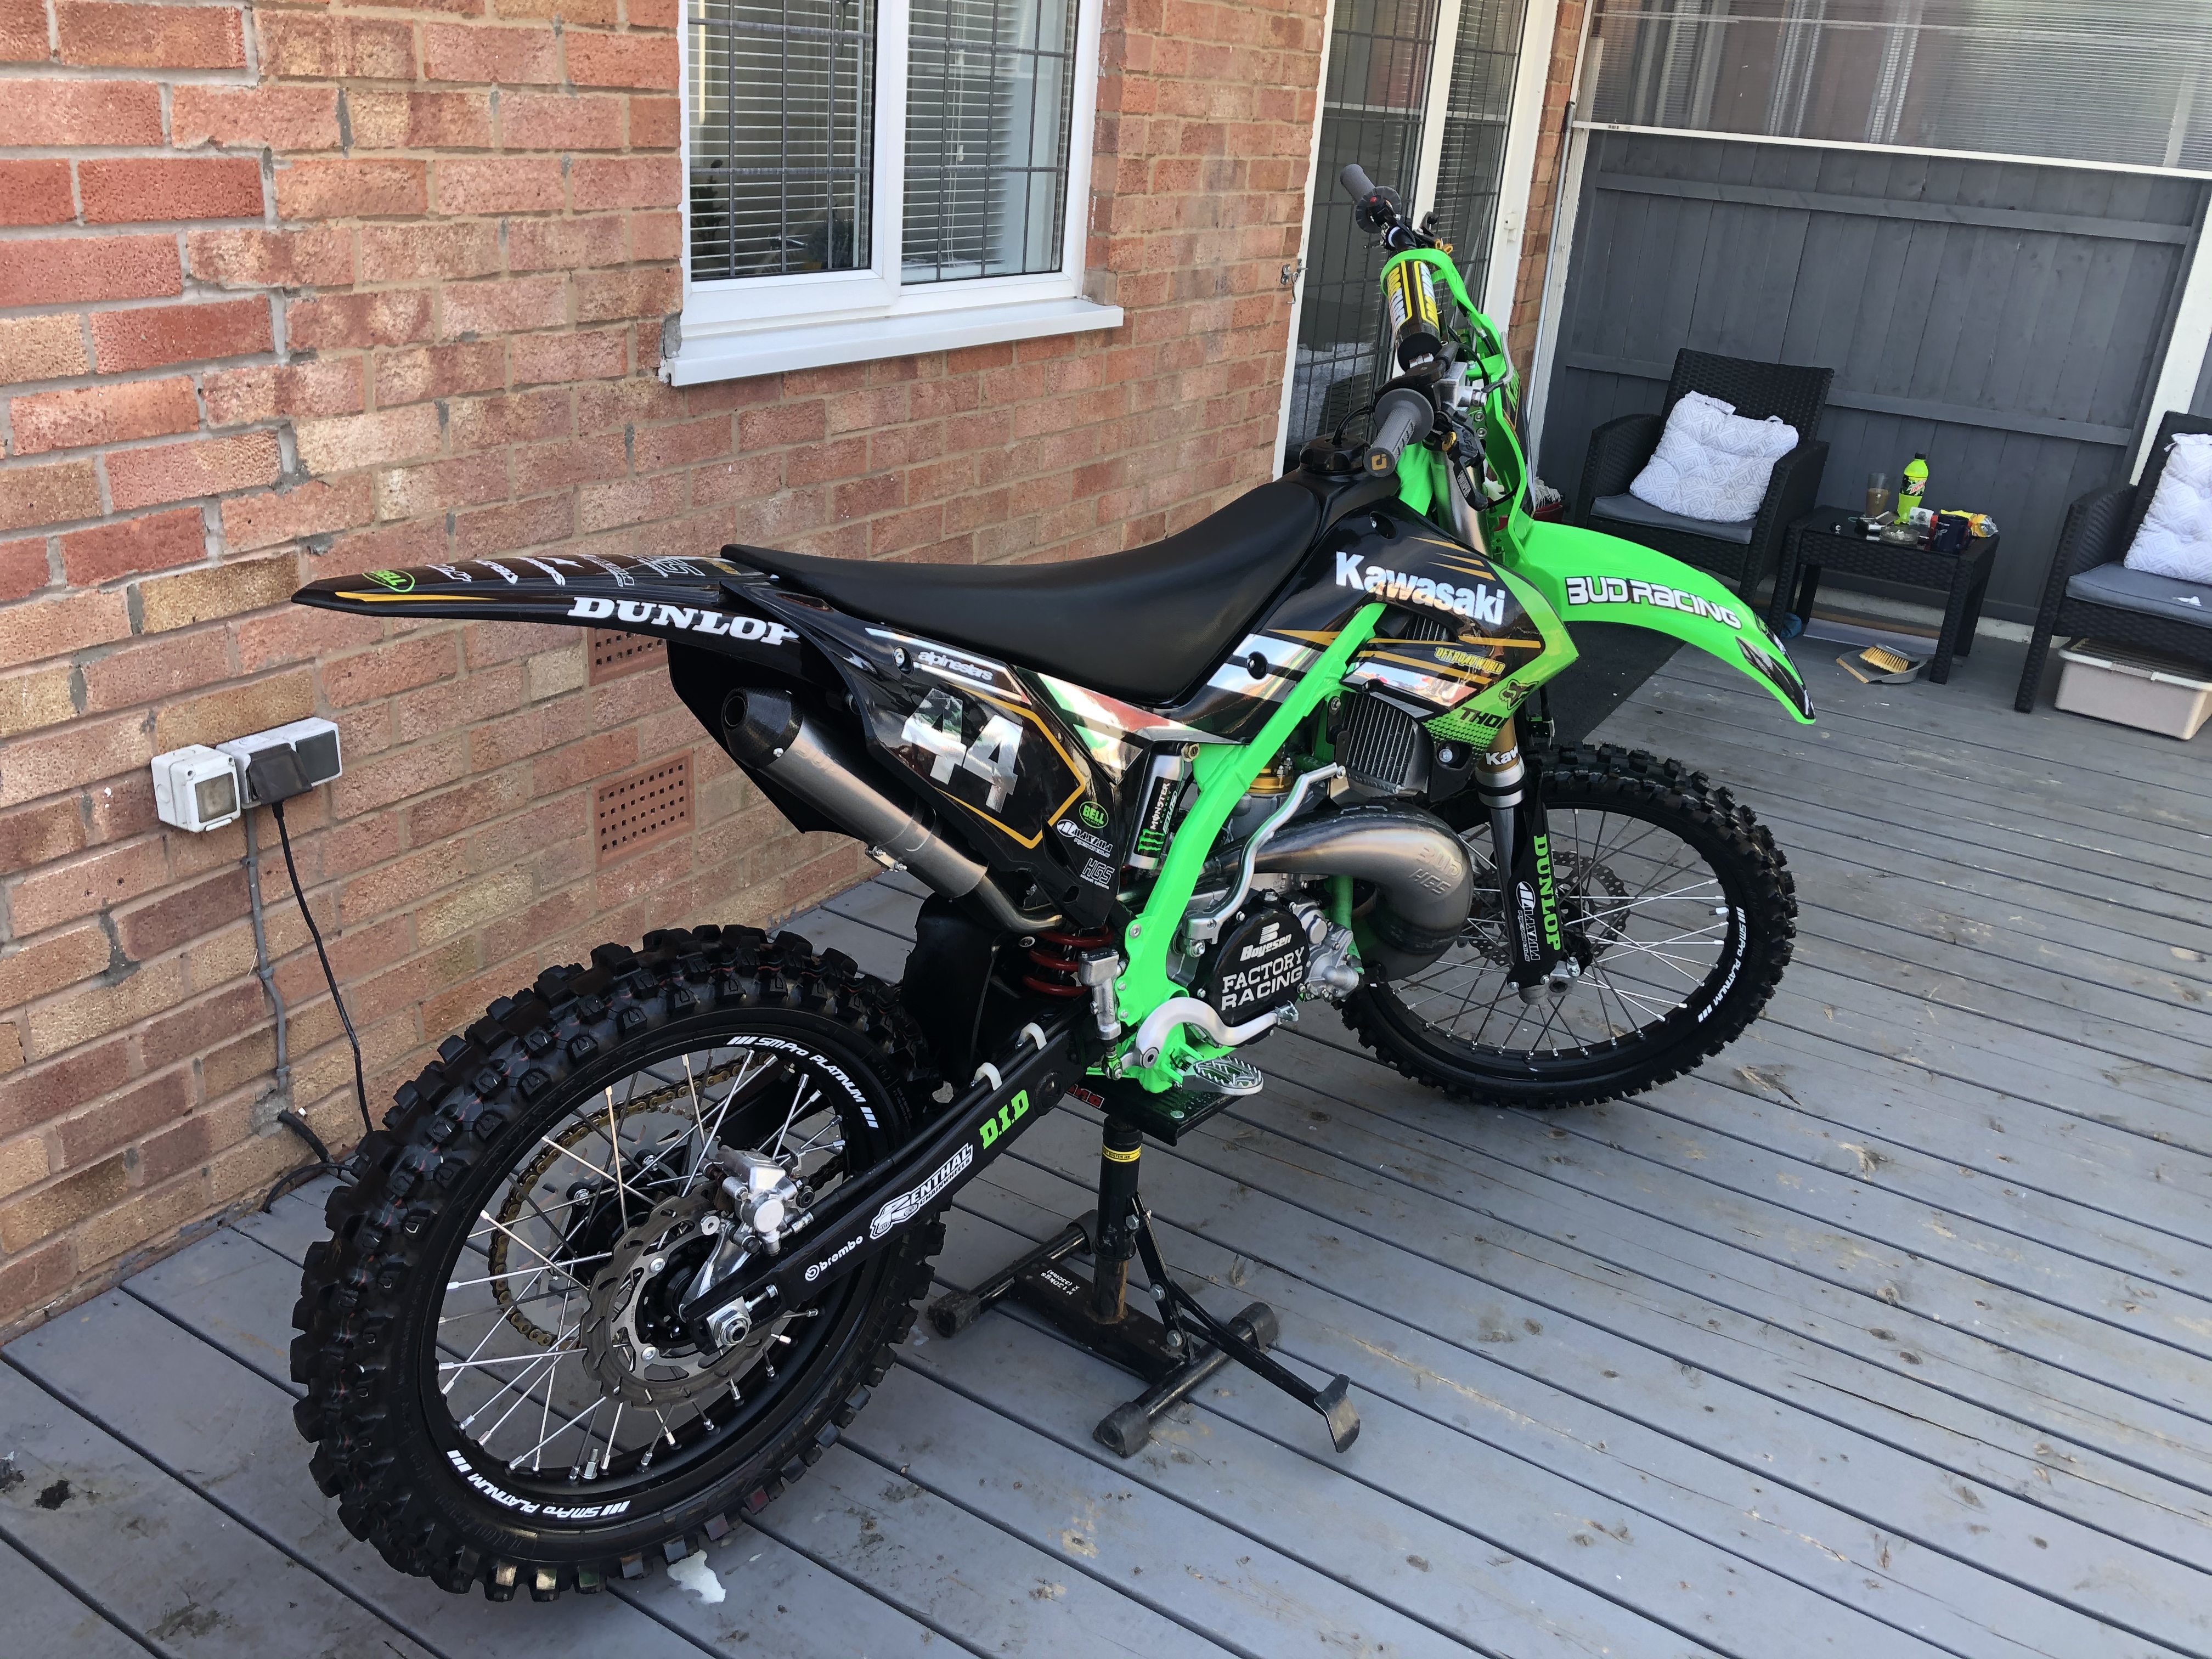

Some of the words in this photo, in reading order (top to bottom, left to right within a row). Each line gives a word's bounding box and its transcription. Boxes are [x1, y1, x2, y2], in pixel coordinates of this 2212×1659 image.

[1335, 551, 1505, 625] Kawasaki
[1565, 575, 1631, 606] BUD
[567, 596, 800, 646] DUNLOP
[918, 651, 994, 681] alpinestars
[1475, 657, 1505, 674] WORLD
[901, 687, 1024, 814] 44
[1082, 805, 1104, 825] BELL
[1150, 782, 1170, 830] MONSTER
[1081, 857, 1115, 884] HGS
[1533, 833, 1561, 951] DUNLOP
[1222, 946, 1305, 994] FACTORY
[1240, 933, 1292, 961] Boyesen
[1221, 966, 1303, 1011] RACING
[1713, 958, 1741, 1006] PLATINUM
[809, 1054, 866, 1102] PLATINUM
[979, 1089, 1029, 1149] D.I.D
[919, 1157, 970, 1205] CHAINWHEELS
[819, 1235, 864, 1272] brembo
[467, 1472, 541, 1514] PLATINUM
